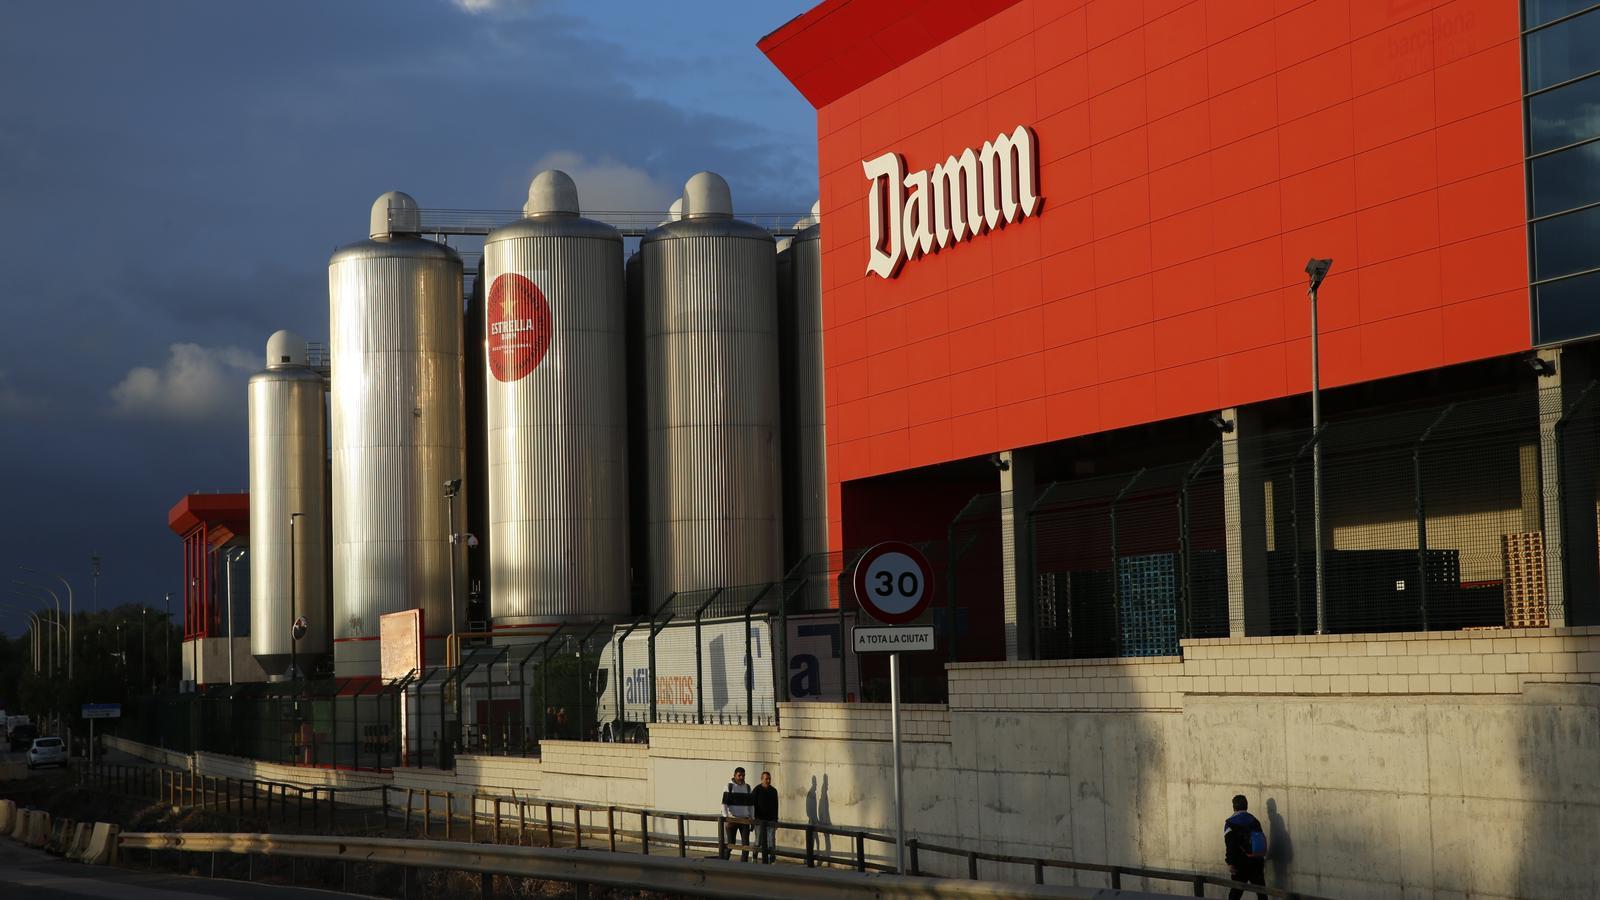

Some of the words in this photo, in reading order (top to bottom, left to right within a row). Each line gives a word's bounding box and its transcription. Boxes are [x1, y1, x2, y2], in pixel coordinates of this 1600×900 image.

[862, 125, 1037, 279] Damm
[491, 319, 533, 335] ESTRELLA
[875, 571, 918, 597] 30
[859, 635, 866, 644] A
[867, 635, 888, 644] TOTA
[889, 634, 899, 643] LA
[901, 633, 928, 643] CIUTAT
[655, 675, 693, 704] OGISTICS
